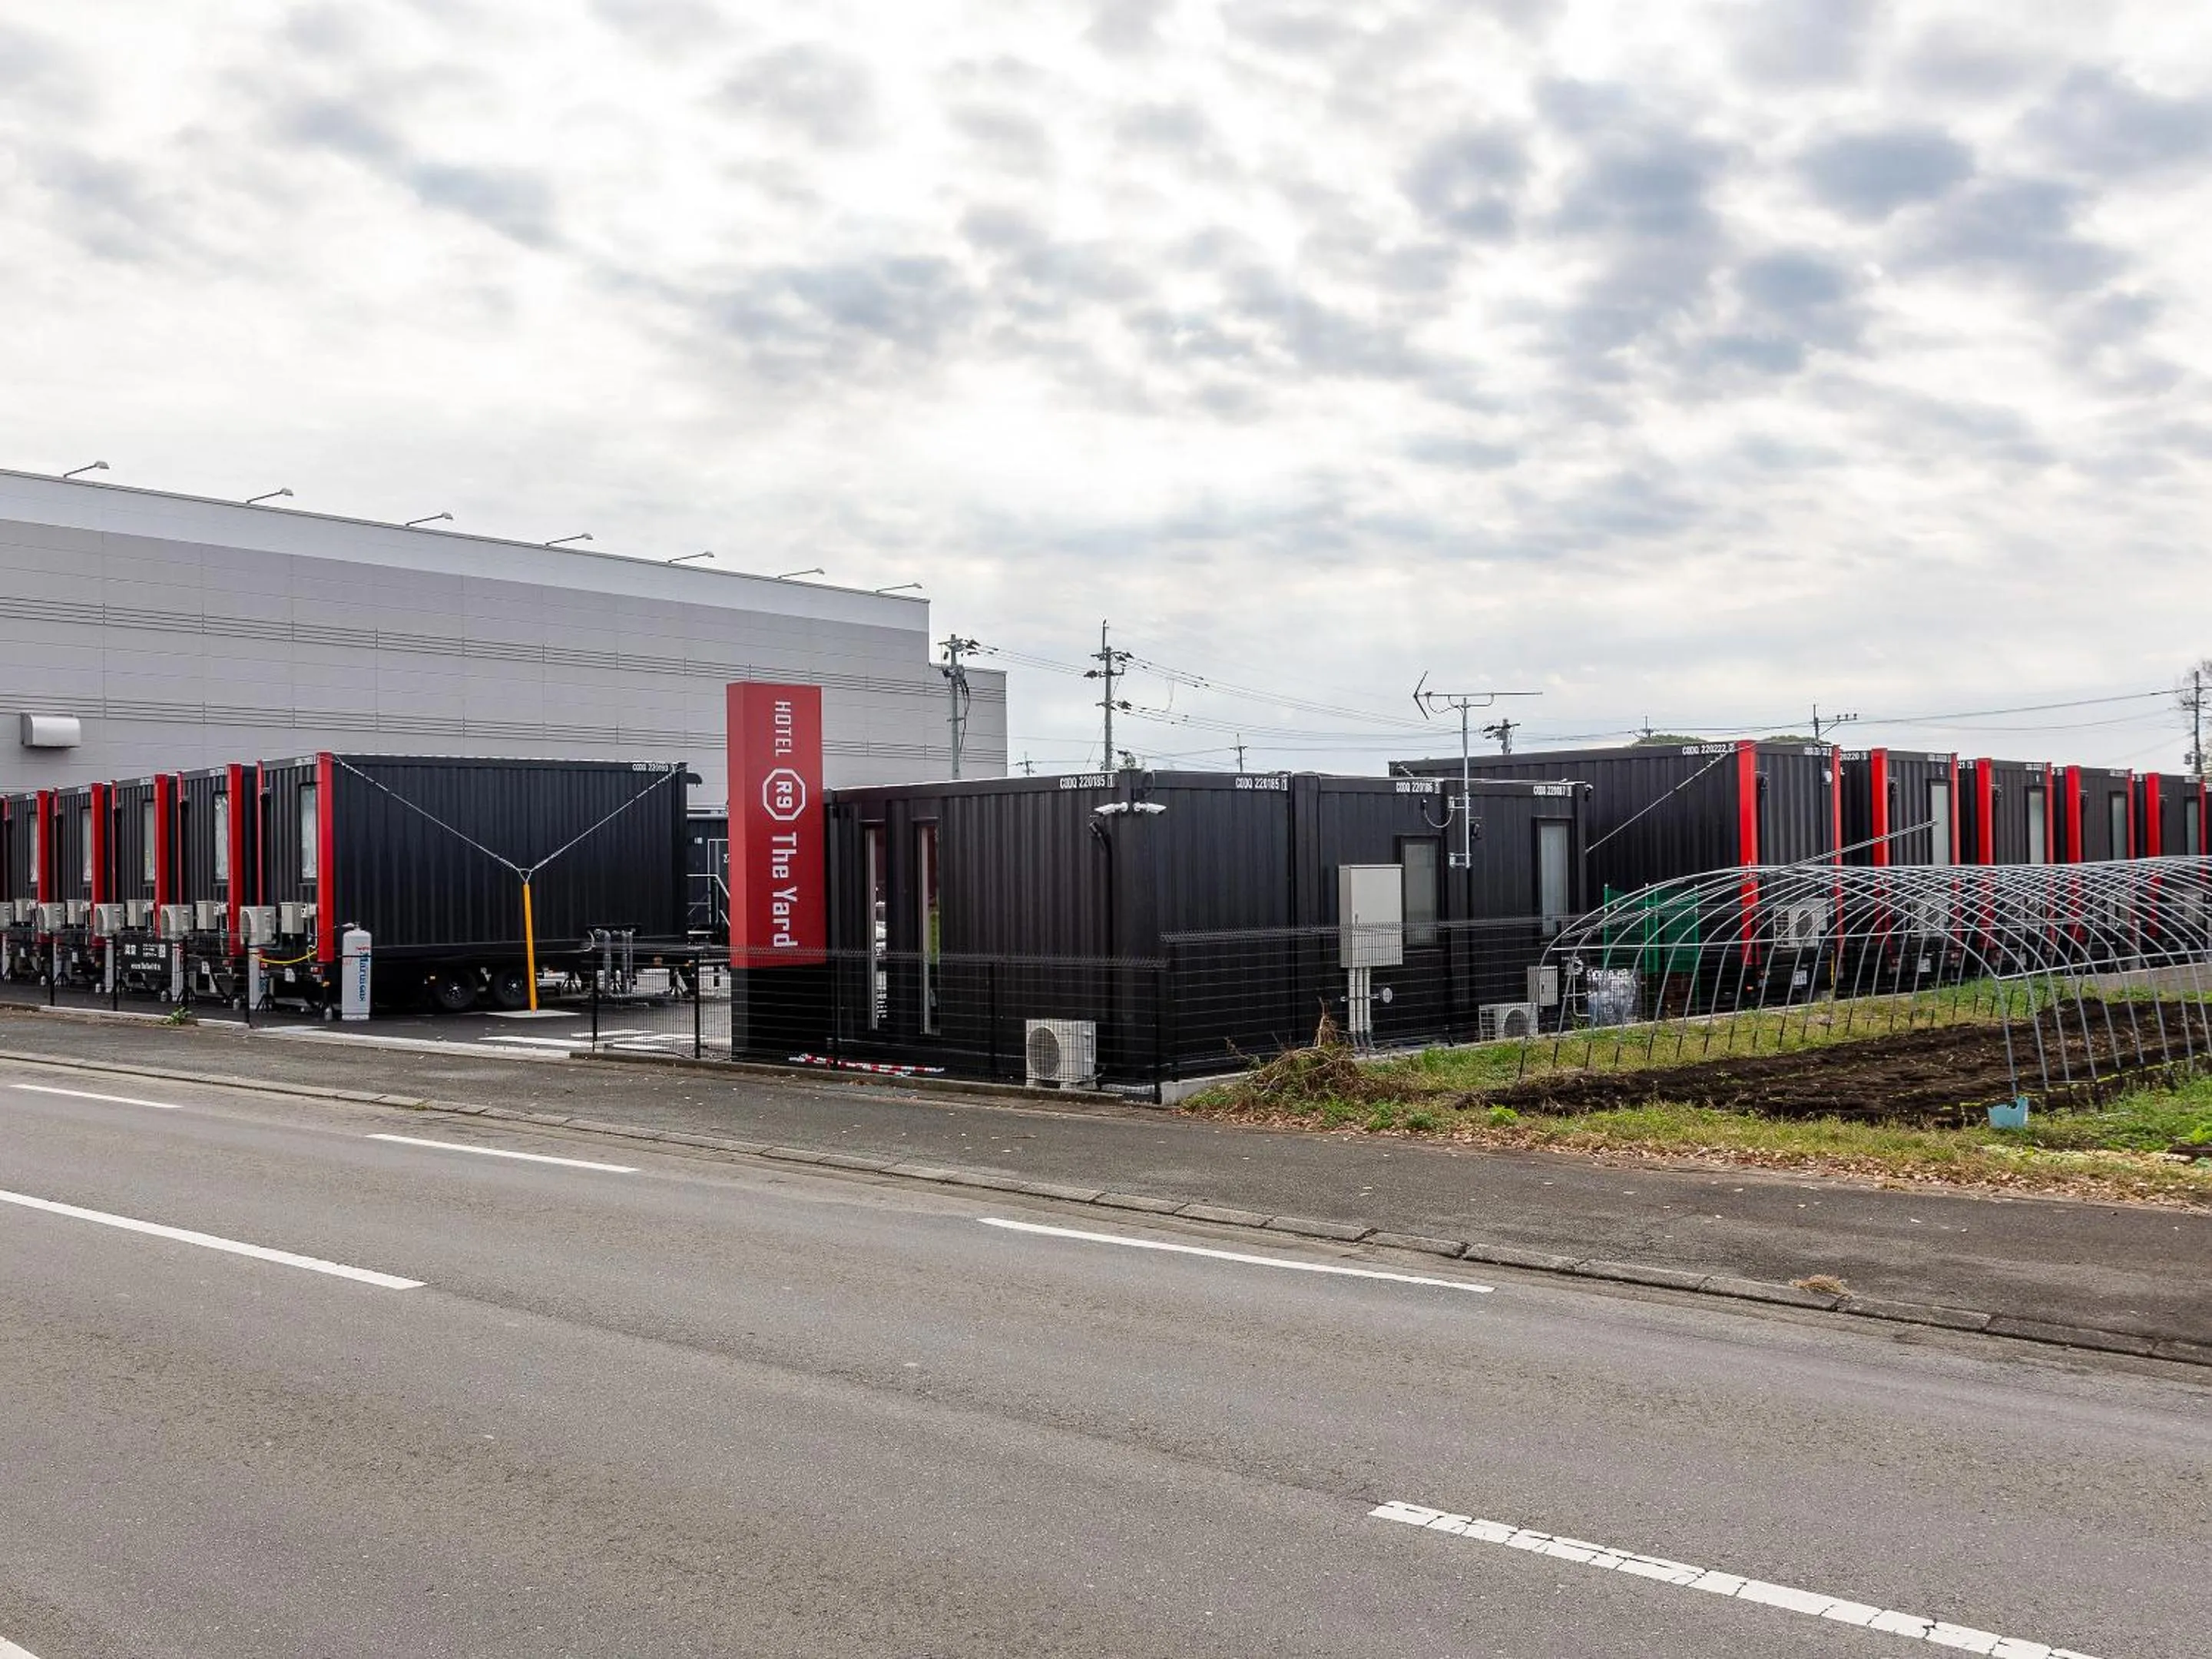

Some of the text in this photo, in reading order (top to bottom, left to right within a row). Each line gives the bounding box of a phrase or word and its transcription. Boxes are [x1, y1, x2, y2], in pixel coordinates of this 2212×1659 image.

[772, 700, 798, 948] HOTEL R9 The Yard
